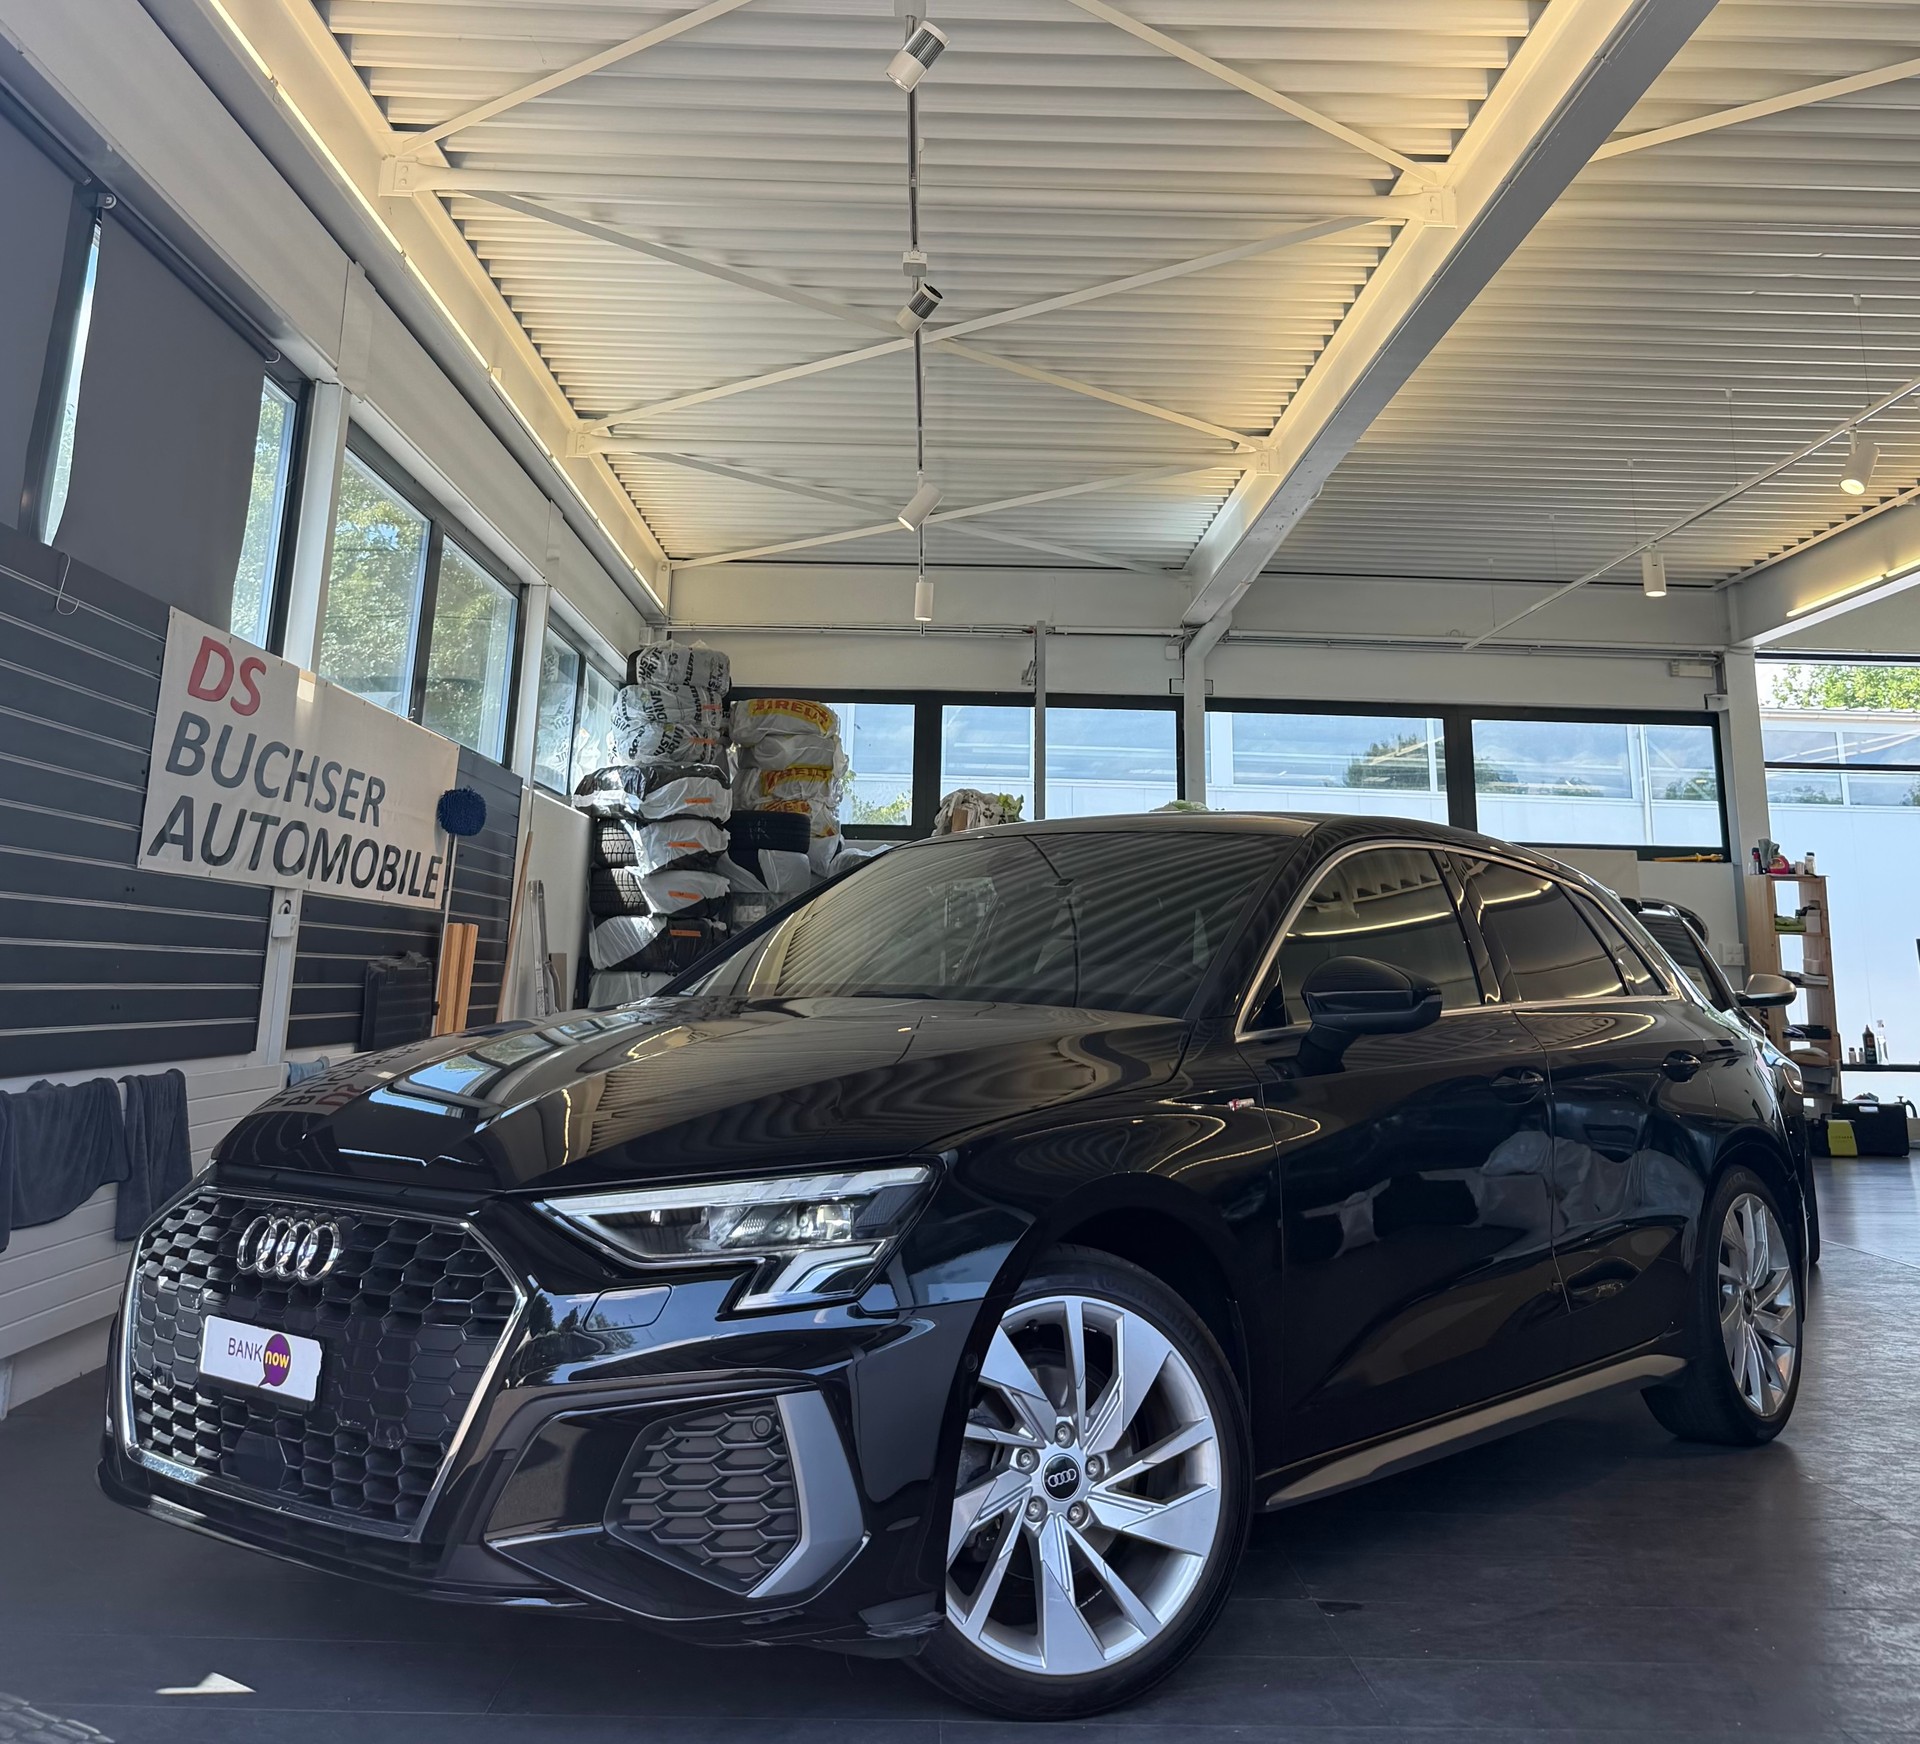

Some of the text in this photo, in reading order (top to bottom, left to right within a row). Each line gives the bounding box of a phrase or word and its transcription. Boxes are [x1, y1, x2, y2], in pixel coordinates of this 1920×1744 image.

[187, 635, 267, 716] DS
[165, 711, 386, 827] BUCHSER
[146, 795, 444, 900] AUTOMOBILE
[227, 1337, 290, 1369] BANK now
